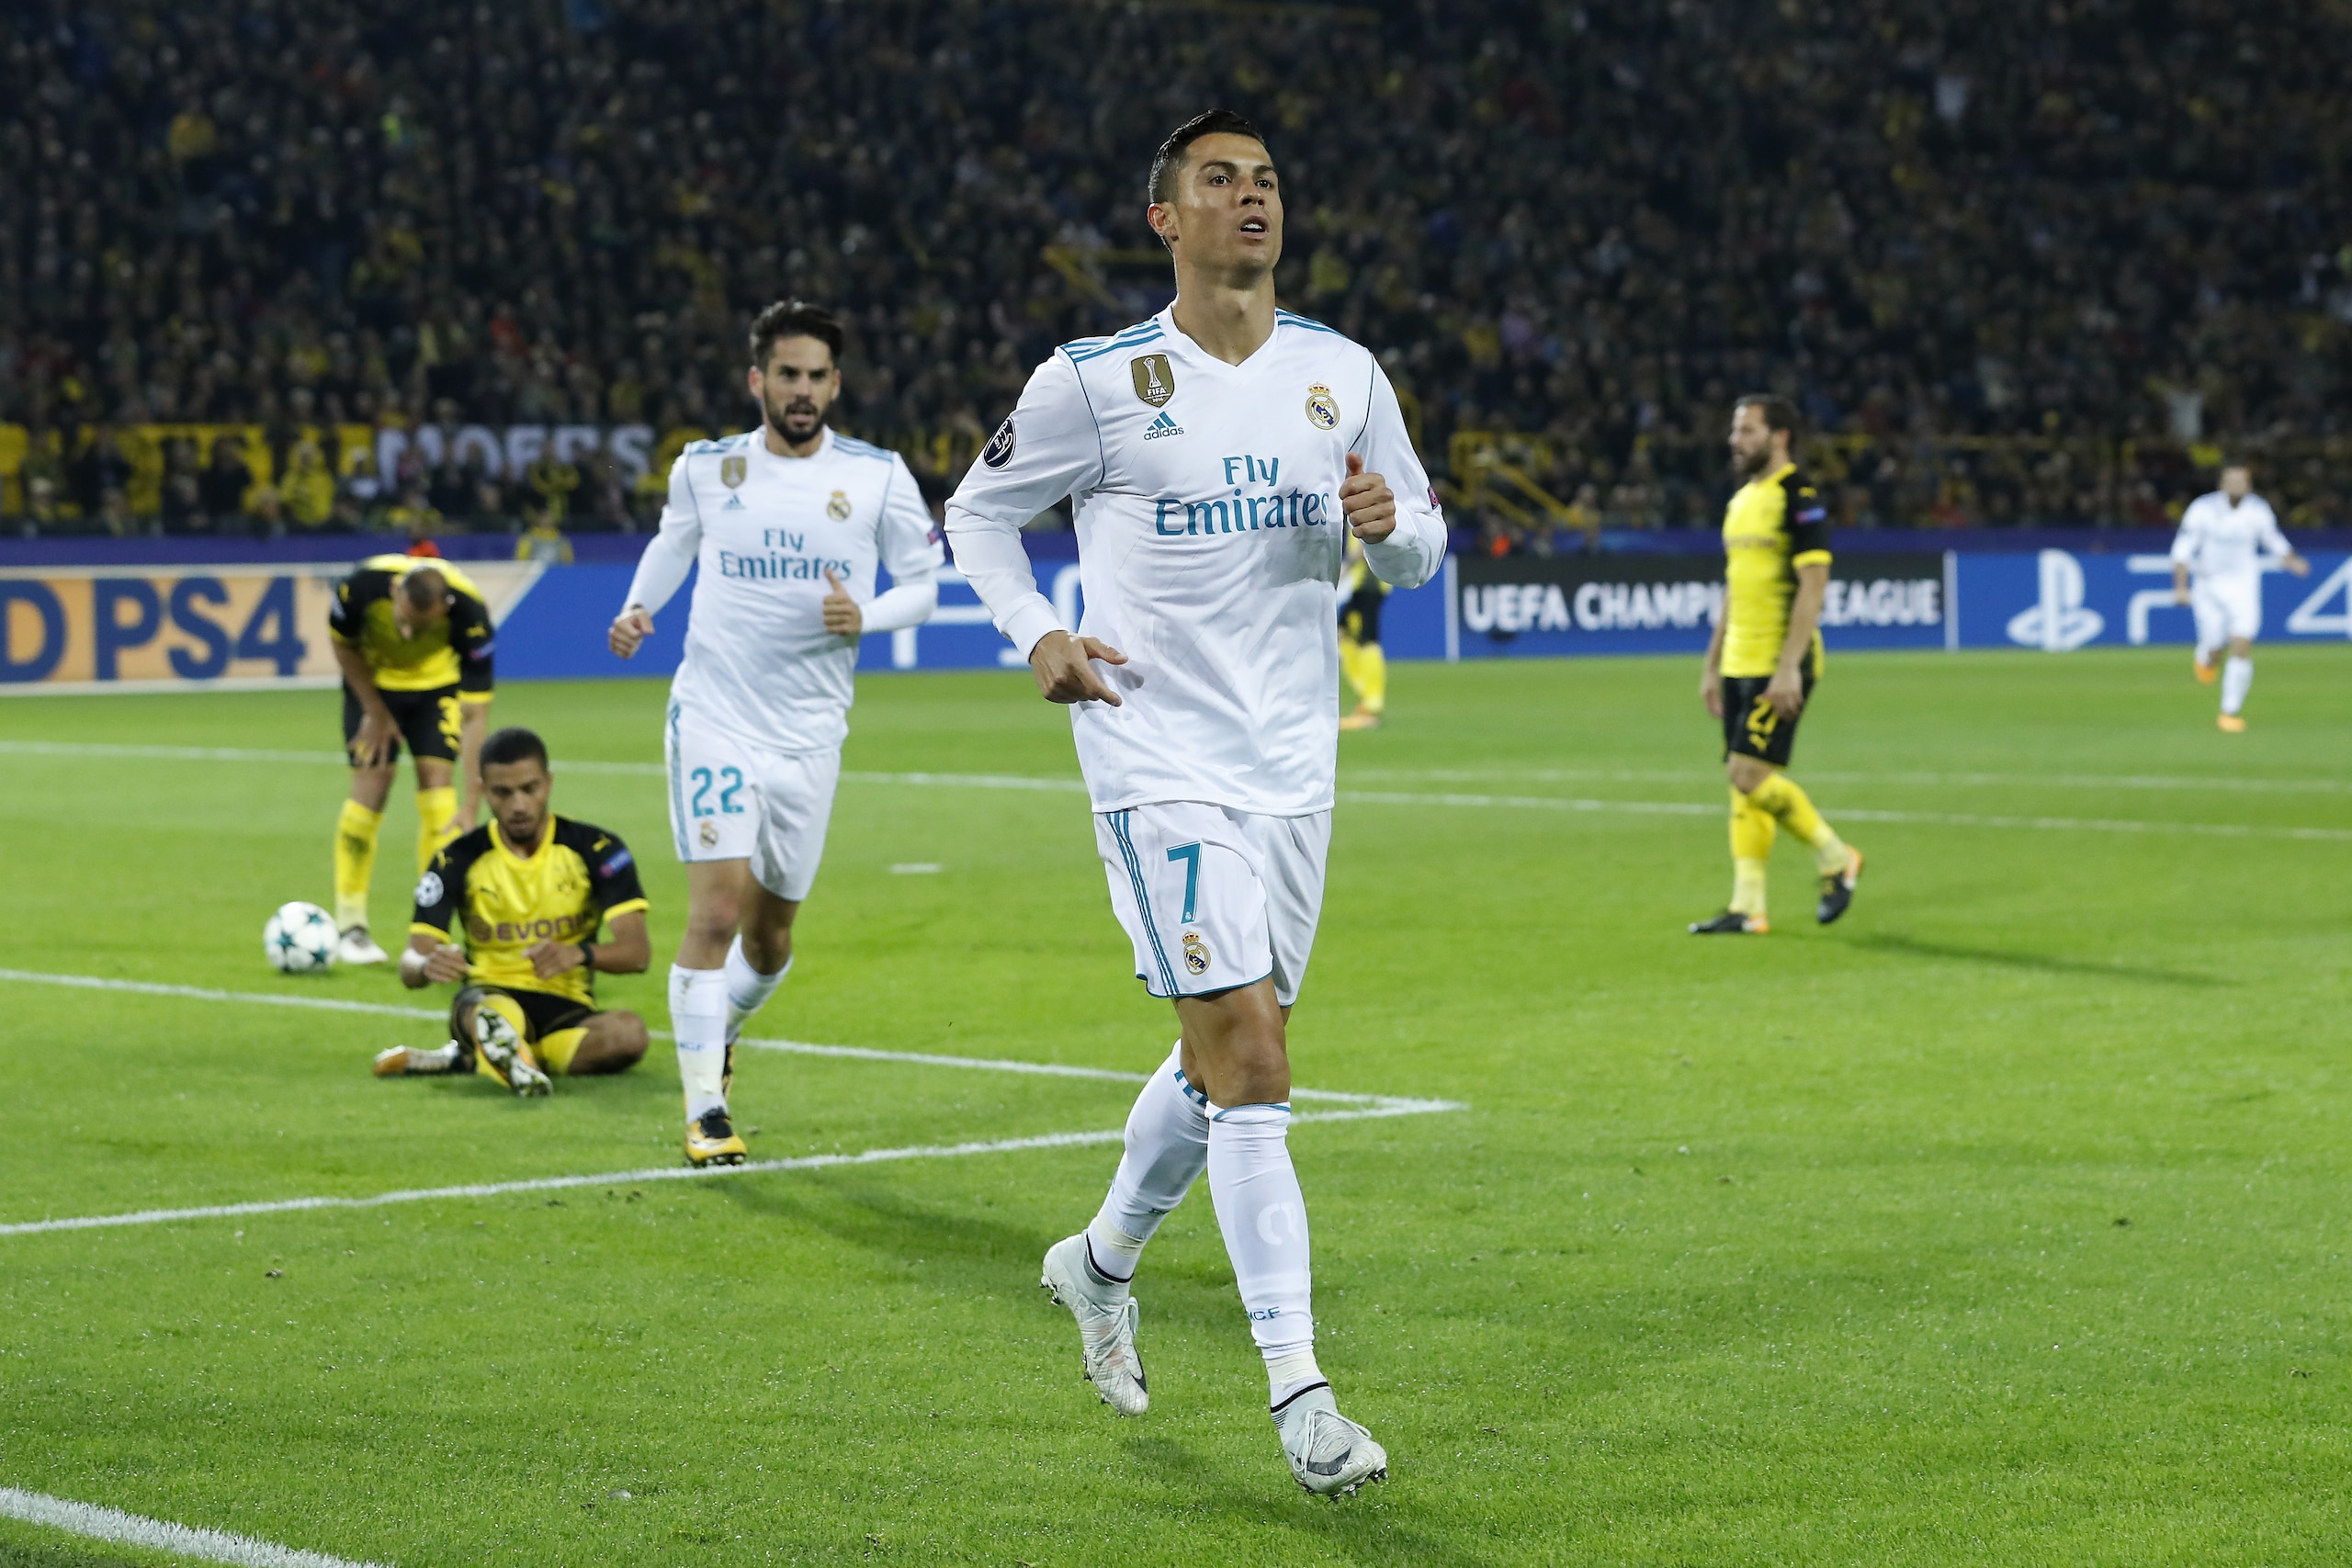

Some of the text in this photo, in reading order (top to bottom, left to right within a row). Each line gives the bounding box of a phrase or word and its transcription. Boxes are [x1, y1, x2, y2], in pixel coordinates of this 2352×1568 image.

[1147, 387, 1166, 396] FIFA
[1143, 426, 1184, 440] adidas
[1223, 455, 1279, 487] Fly
[1156, 488, 1329, 536] Emirates
[763, 528, 803, 550] Fly
[720, 551, 851, 580] Emirates
[1464, 579, 1941, 632] UEFA CHAMPI EAGUE
[95, 576, 307, 682] PS4
[691, 766, 744, 818] 22
[1166, 841, 1201, 924] 7
